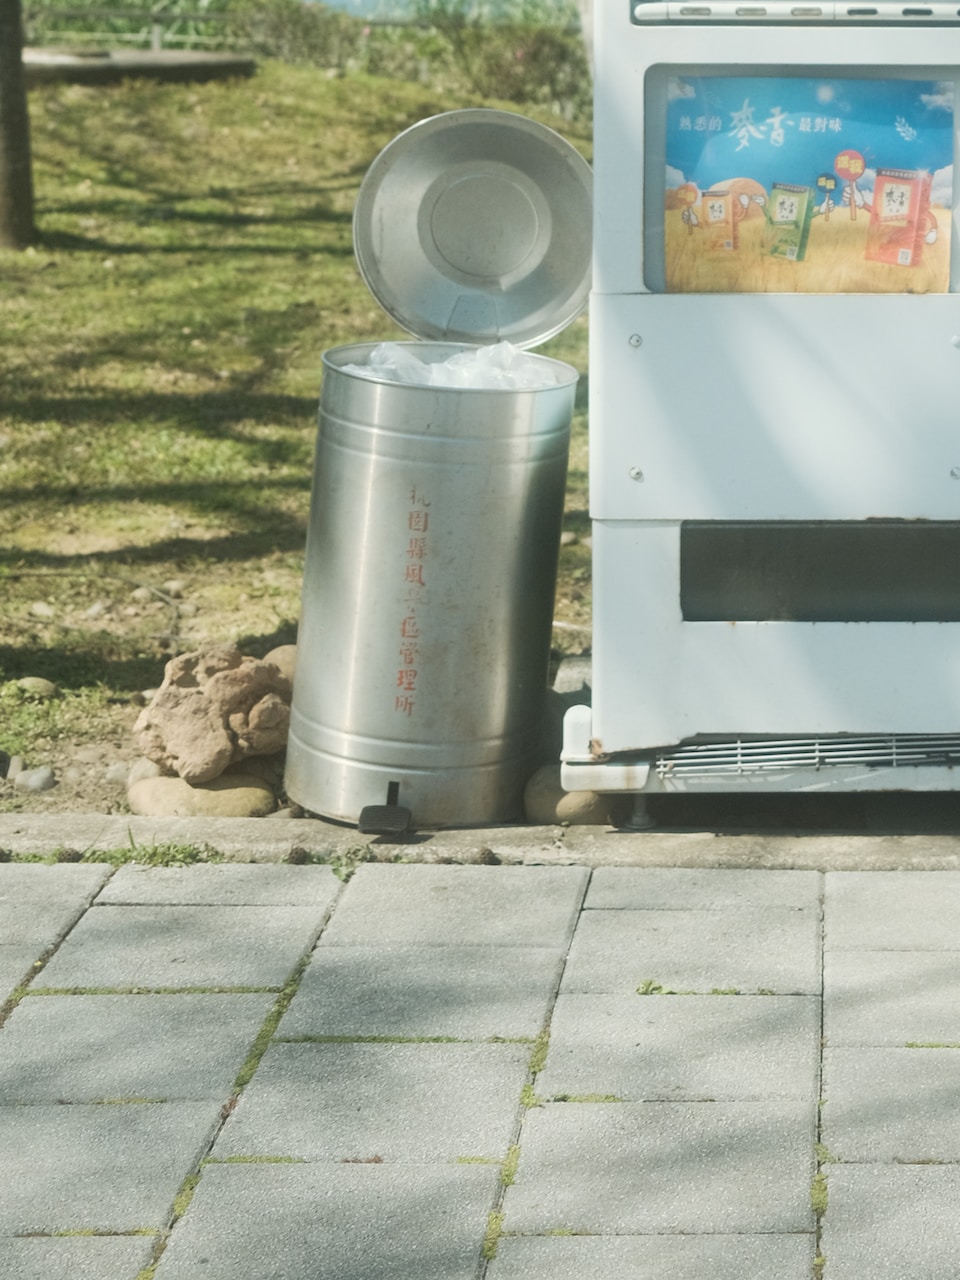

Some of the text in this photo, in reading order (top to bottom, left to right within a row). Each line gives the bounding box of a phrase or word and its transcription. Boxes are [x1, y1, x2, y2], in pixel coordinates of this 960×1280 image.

[679, 98, 842, 152] 熟悉的 麥香 最對味
